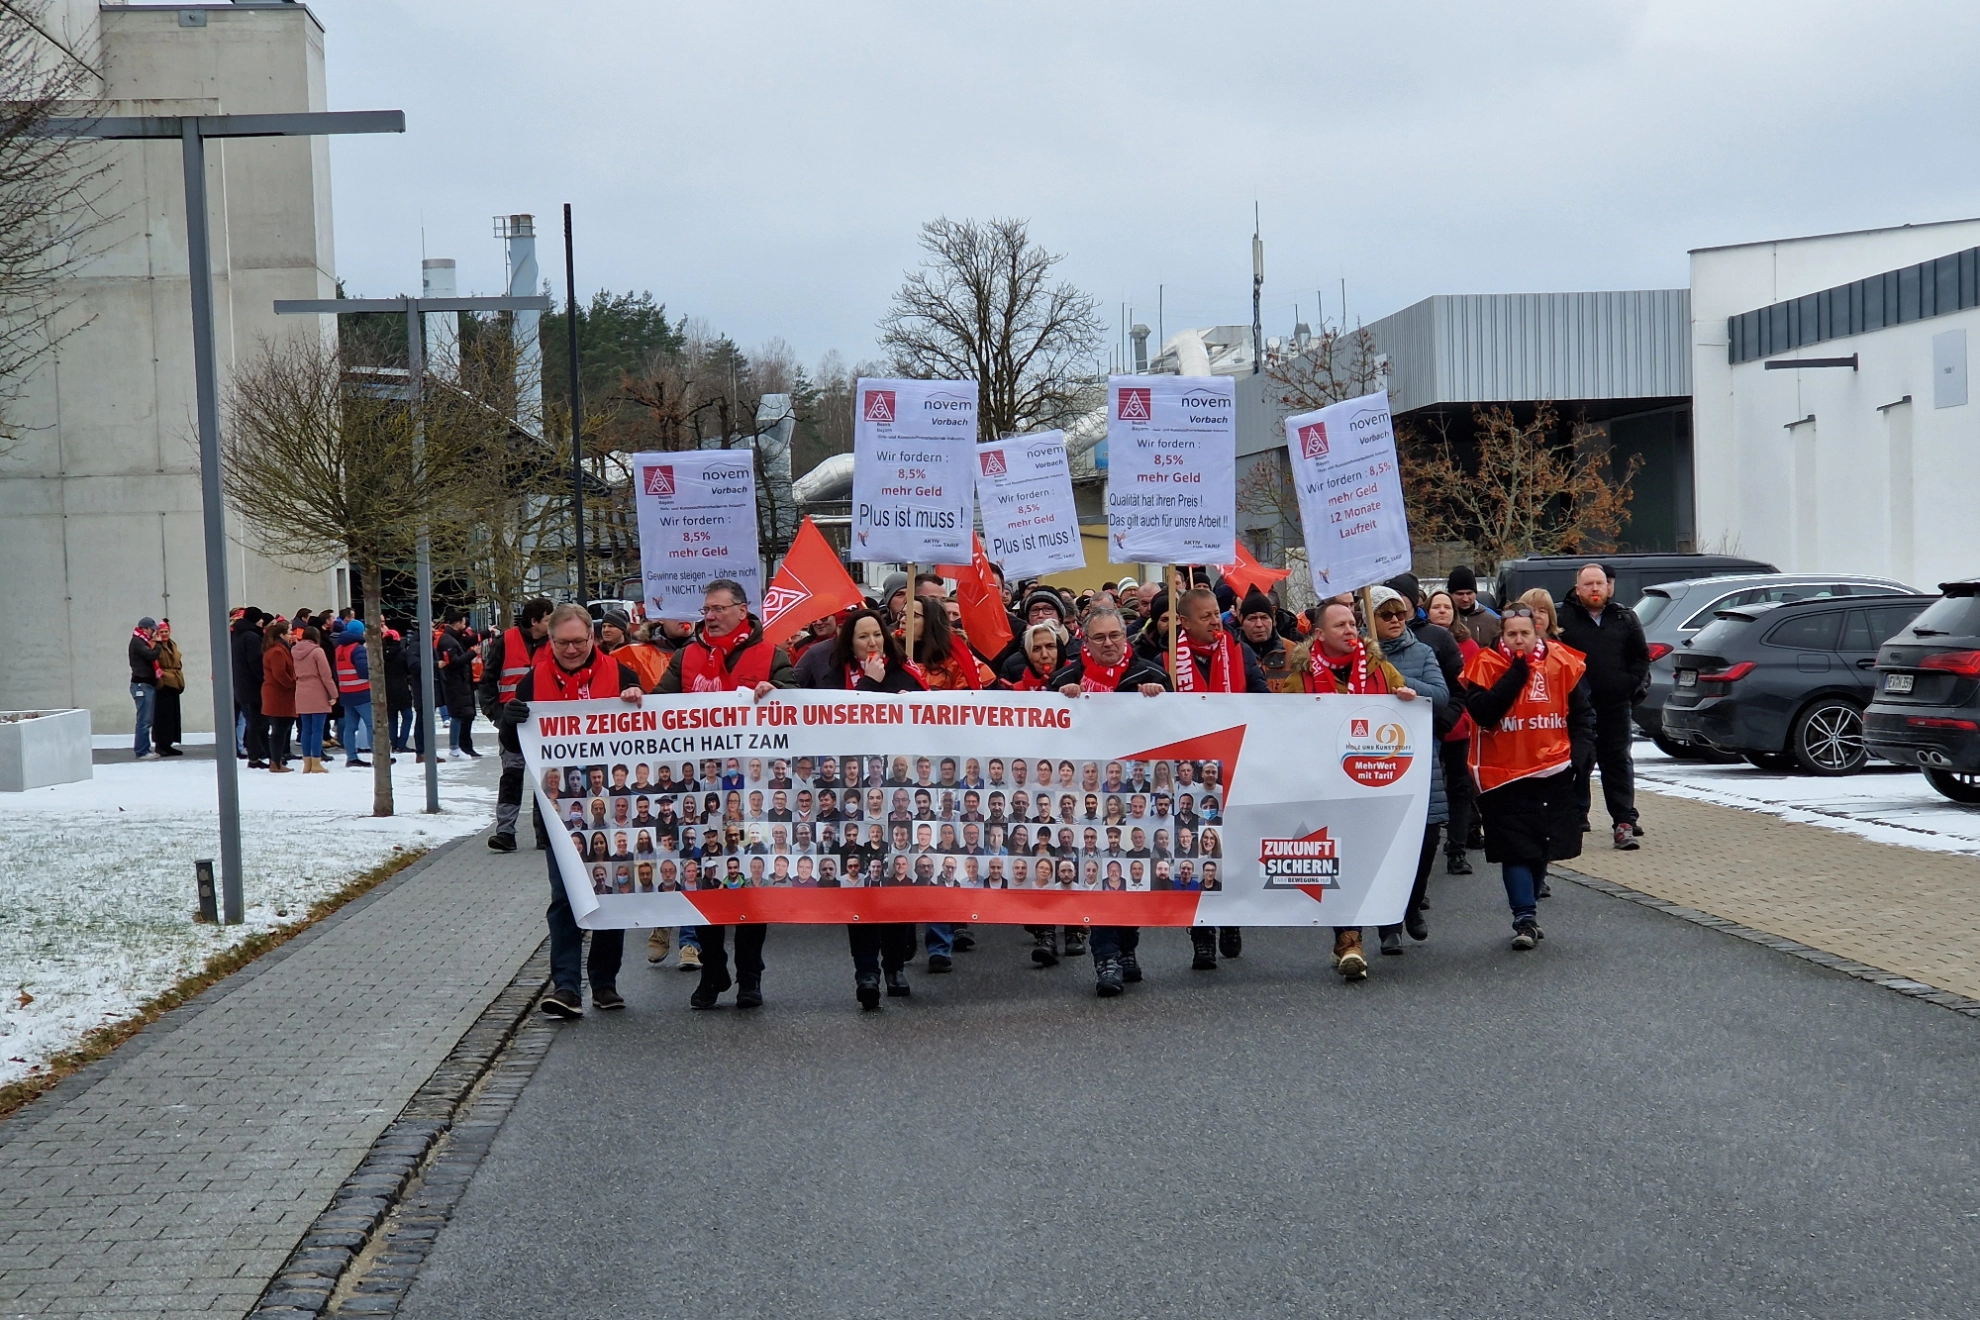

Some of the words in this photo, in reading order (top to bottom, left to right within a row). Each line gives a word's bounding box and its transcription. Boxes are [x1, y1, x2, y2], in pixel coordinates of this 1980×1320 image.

[924, 400, 972, 410] novem
[1182, 397, 1231, 408] novem
[932, 417, 968, 426] Vorbach
[1190, 415, 1228, 424] Vorbach
[1350, 412, 1389, 431] novem
[1136, 439, 1155, 448] Wir
[1158, 438, 1195, 448] fordern
[1360, 430, 1389, 445] Vorbach
[876, 451, 896, 461] Wir
[900, 451, 942, 462] fordern
[1027, 446, 1063, 458] novem
[1035, 459, 1063, 469] Vorbach
[1154, 454, 1184, 466] 8,5%
[702, 470, 749, 480] novem
[898, 468, 926, 480] 8,5%
[1136, 472, 1169, 482] mehr
[1172, 472, 1200, 483] Geld
[1306, 482, 1324, 494] Wir
[1327, 472, 1362, 488] fordern
[1369, 461, 1391, 476] 8,5%
[712, 486, 748, 494] Vorbach
[881, 485, 912, 496] mehr
[916, 486, 942, 496] Geld
[1328, 492, 1353, 506] mehr
[1356, 482, 1378, 498] Geld
[998, 496, 1014, 504] Wir
[1016, 490, 1050, 501] fordern
[1110, 493, 1140, 506] Qualität
[1142, 494, 1154, 506] hat
[1178, 494, 1198, 508] Preis
[1018, 504, 1040, 514] 8,5%
[1330, 512, 1342, 524] 12
[1345, 502, 1381, 520] Monate
[660, 517, 679, 526] Wir
[683, 515, 725, 526] fordern
[860, 504, 890, 526] Plus
[895, 505, 911, 527] ist
[916, 510, 954, 528] muss
[1008, 519, 1031, 529] mehr
[1034, 514, 1055, 524] Geld
[1110, 513, 1126, 526] Das
[1140, 514, 1160, 527] auch
[1162, 514, 1172, 527] für
[1174, 518, 1196, 528] unsre
[1198, 514, 1221, 528] Arbeit
[1340, 520, 1377, 539] Laufzeit
[683, 532, 711, 543] 8,5%
[993, 538, 1020, 556] Plus
[1021, 534, 1036, 550] ist
[1038, 530, 1068, 548] muss
[669, 548, 698, 558] mehr
[702, 546, 728, 556] Geld
[647, 570, 677, 580] Gewinne
[680, 570, 706, 581] steigen
[715, 569, 737, 578] Löhne
[739, 567, 757, 577] nicht
[672, 584, 696, 595] NICHT
[539, 716, 581, 737] WIR
[586, 711, 657, 735] ZEIGEN
[662, 706, 750, 730] GESICHT
[756, 701, 797, 726] FÜR
[803, 704, 903, 726] UNSEREN
[909, 704, 1071, 728] TARIFVERTRAG
[1500, 715, 1524, 732] Wir
[541, 742, 604, 760] NOVEM
[609, 737, 694, 756] VORBACH
[700, 734, 743, 751] HALT
[748, 733, 789, 750] ZAM
[1355, 761, 1396, 770] MehrWert
[1358, 771, 1372, 779] mit
[1374, 771, 1394, 779] Tarif
[1264, 841, 1332, 855] ZUKUNFT
[1267, 859, 1337, 874] SICHERN.
